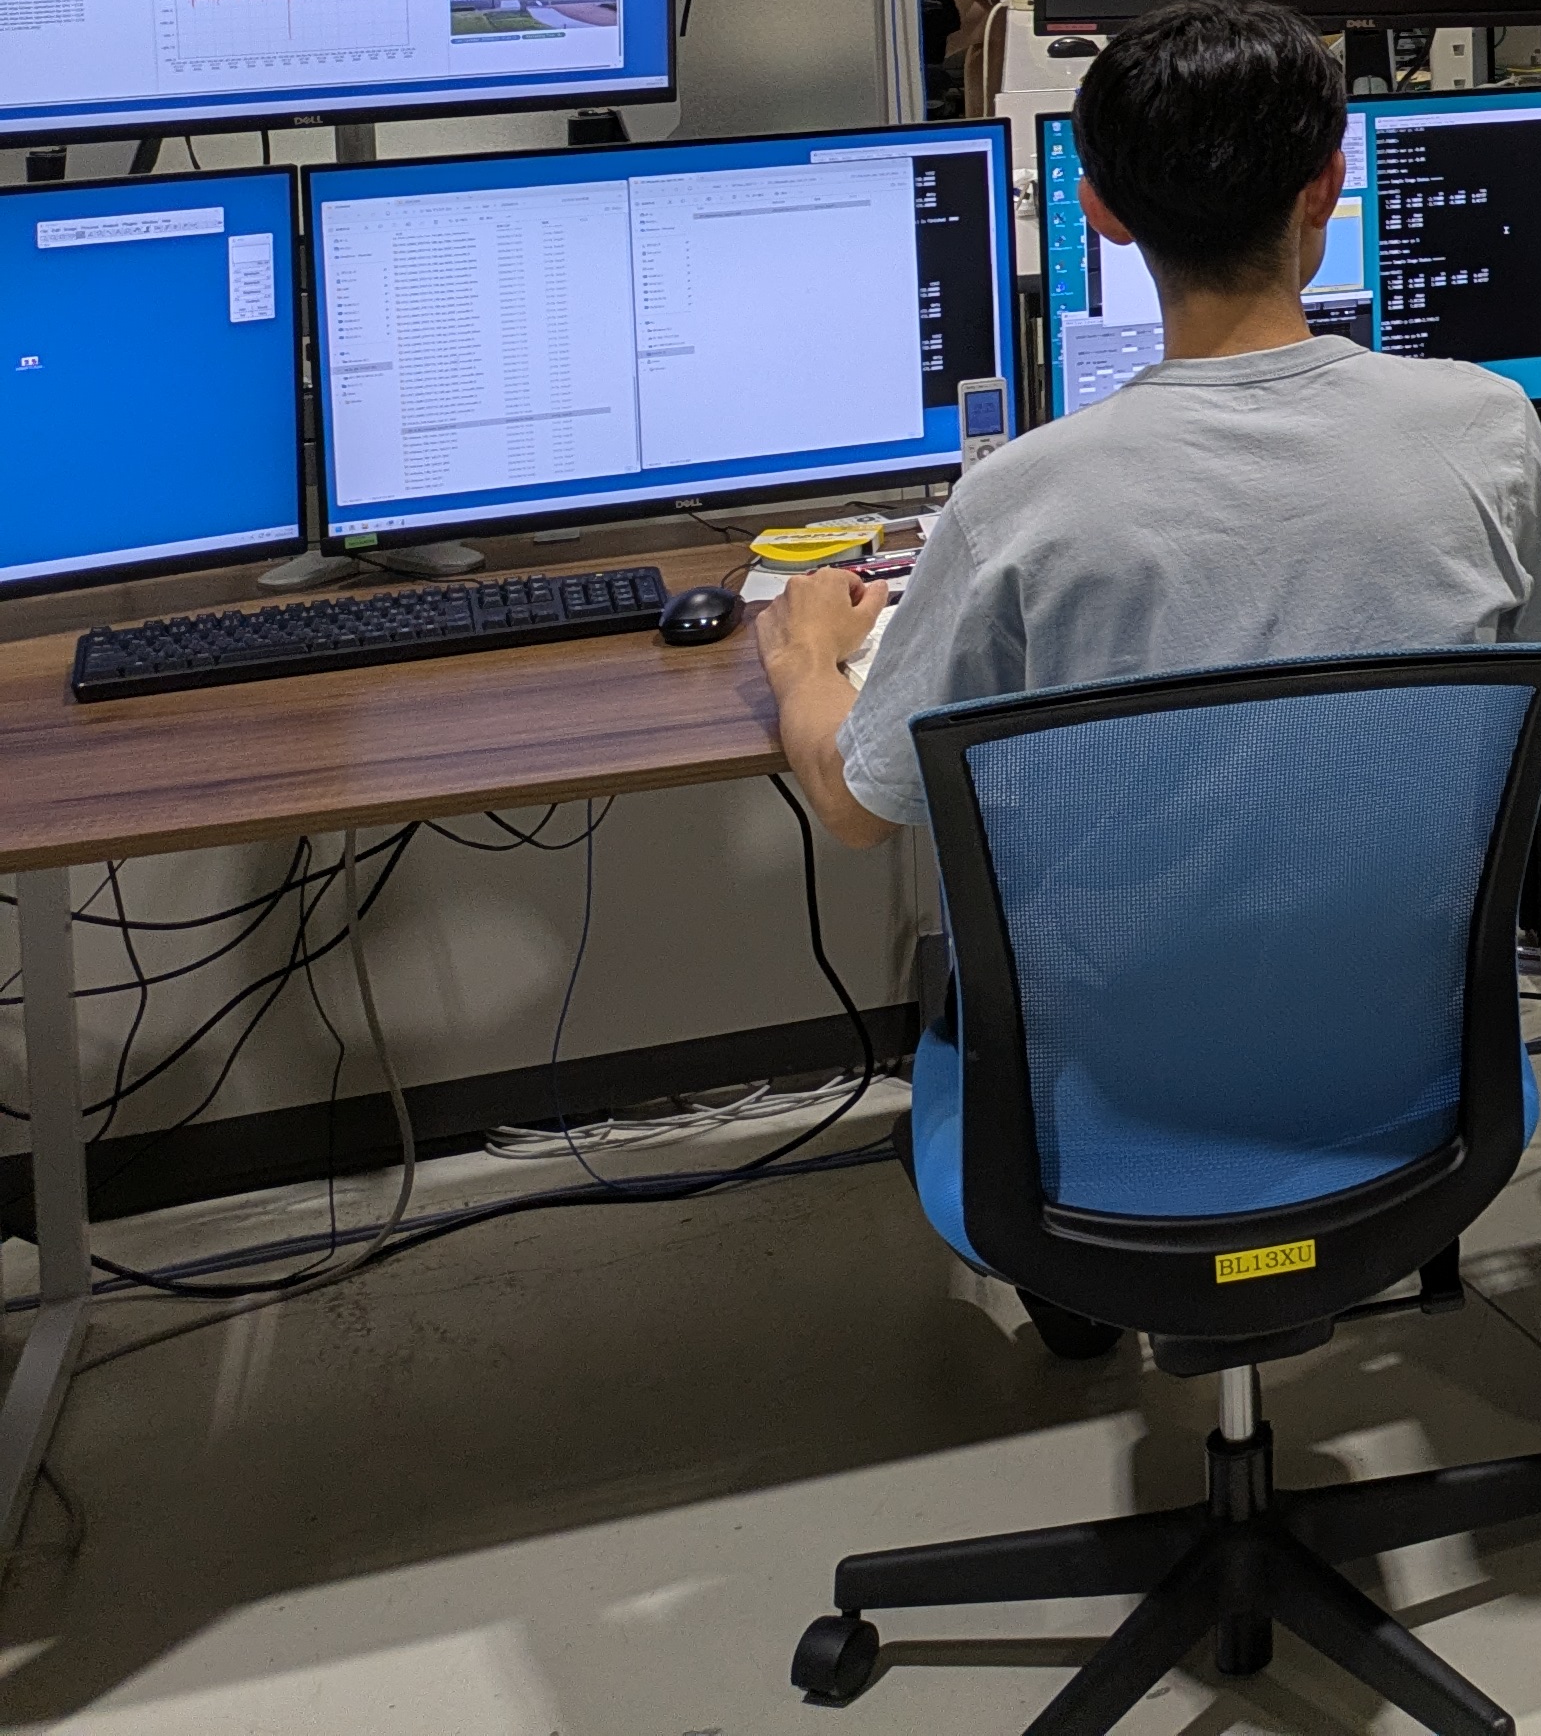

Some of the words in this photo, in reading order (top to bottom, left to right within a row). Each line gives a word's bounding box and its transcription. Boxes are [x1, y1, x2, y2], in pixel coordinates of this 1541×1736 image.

[1346, 19, 1376, 28] DELL
[293, 115, 324, 126] DELL
[675, 498, 703, 510] DELL
[1218, 1244, 1313, 1277] BL13XU
